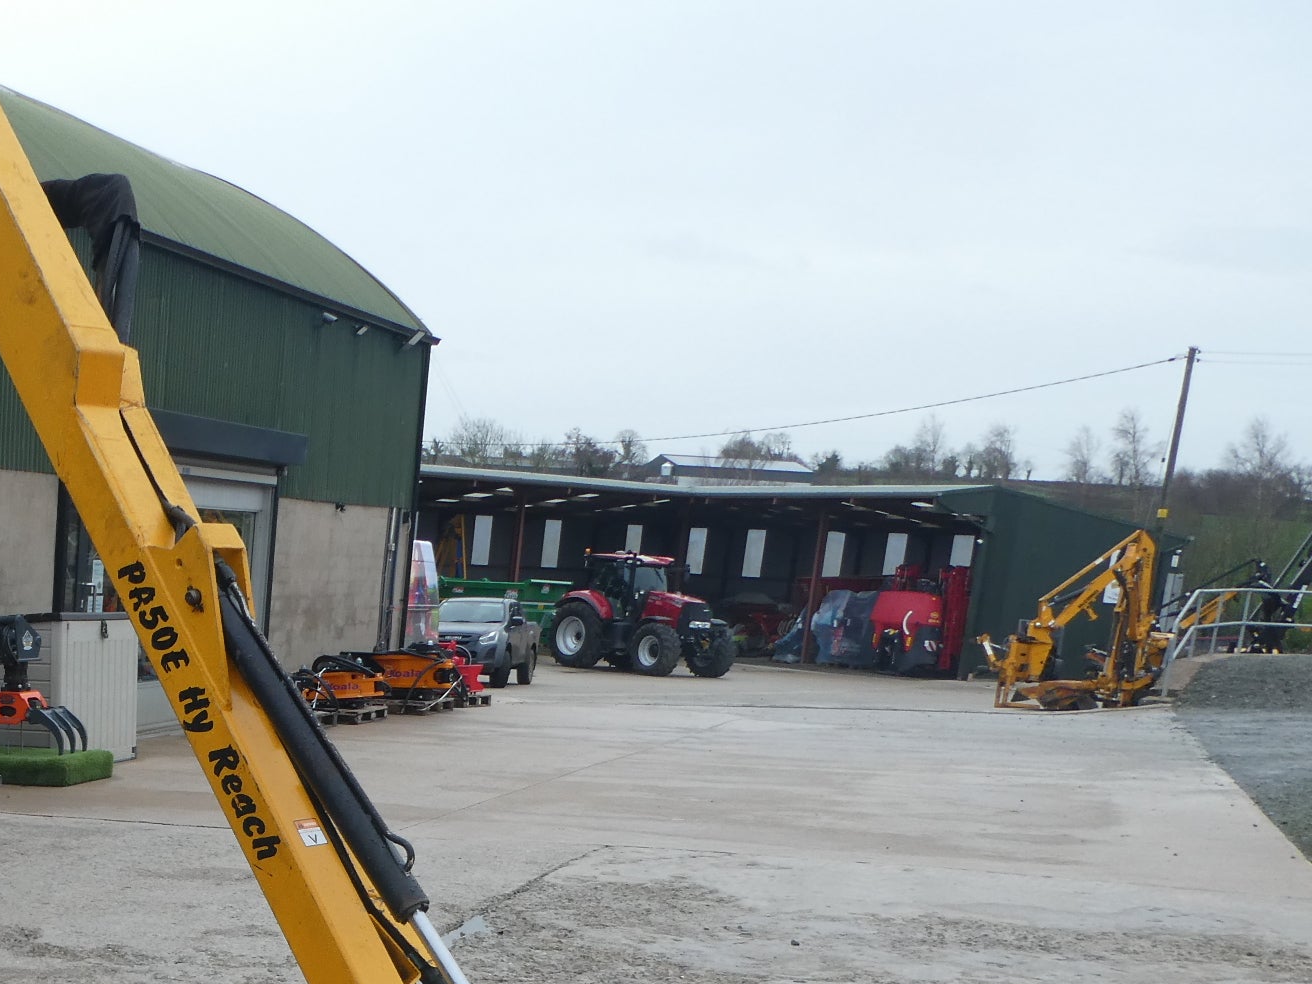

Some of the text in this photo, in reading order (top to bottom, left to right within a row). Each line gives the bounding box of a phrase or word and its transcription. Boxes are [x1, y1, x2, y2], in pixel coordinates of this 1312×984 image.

[117, 561, 282, 861] PA50E Hy Reach
